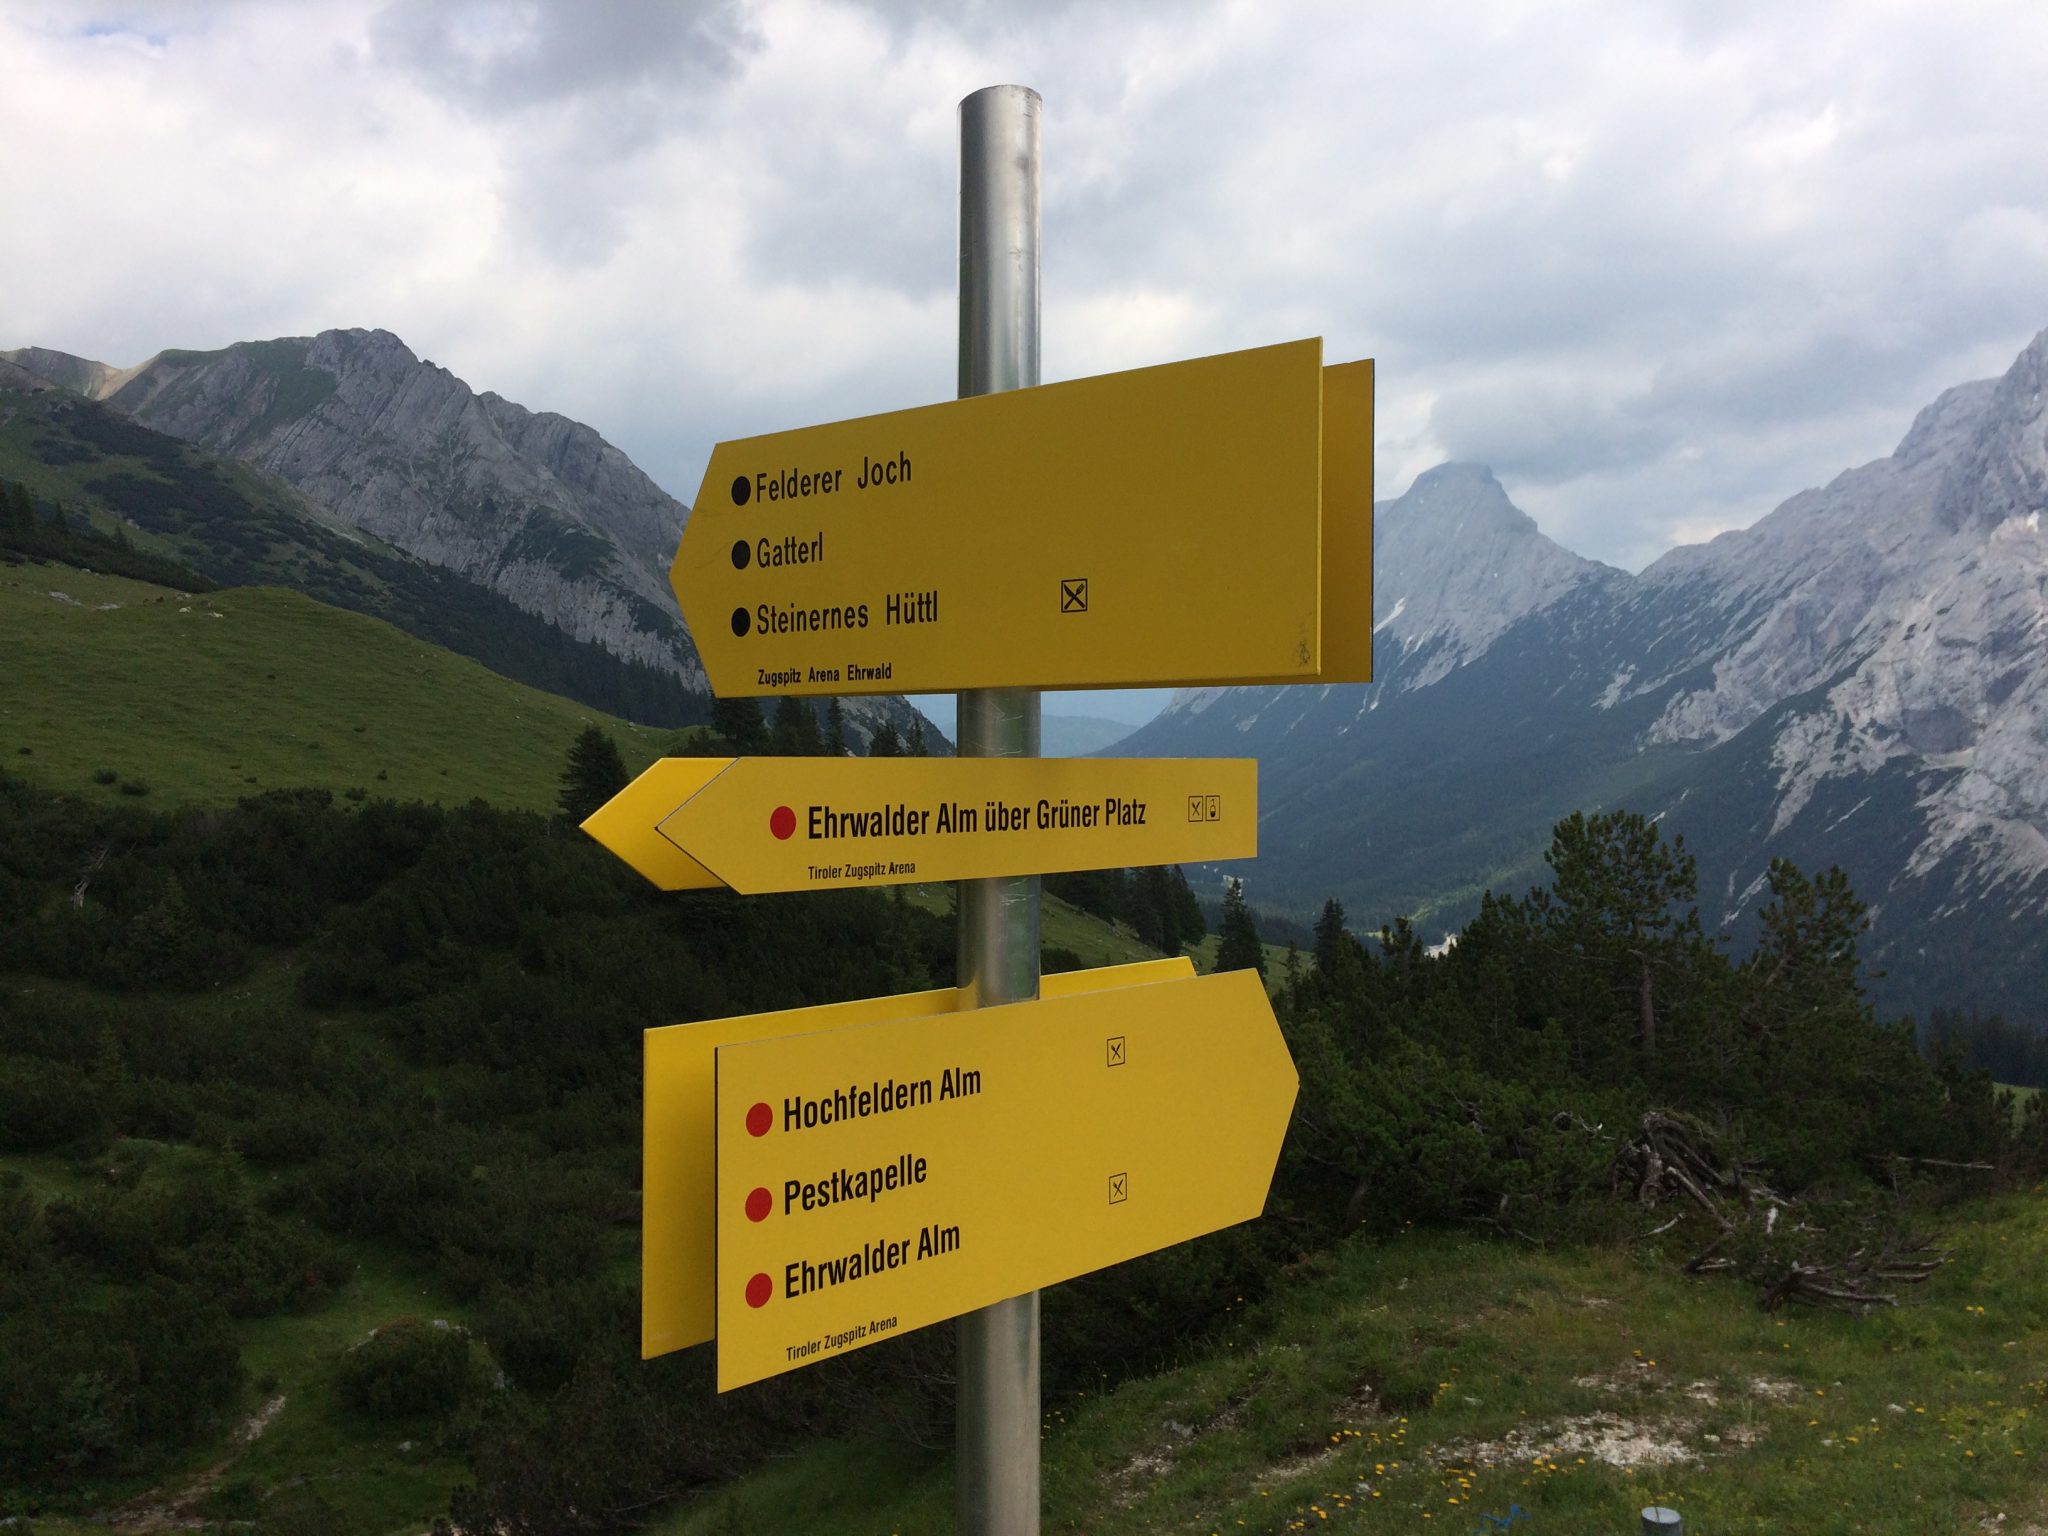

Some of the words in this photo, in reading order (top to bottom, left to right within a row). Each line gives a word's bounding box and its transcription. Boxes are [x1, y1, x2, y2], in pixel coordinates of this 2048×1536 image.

[756, 467, 843, 503] Felderer
[857, 450, 912, 490] Joch
[756, 531, 823, 569] Gatterl
[757, 602, 869, 635] Steinernes
[886, 590, 938, 626] Hüttl
[757, 667, 802, 688] Zugspitz
[808, 666, 840, 683] Arena
[847, 662, 892, 681] Ehrwald
[808, 803, 930, 840] Ehrwalder
[935, 802, 977, 834] Alm
[985, 801, 1031, 832] über
[1036, 799, 1100, 830] Grüner
[1105, 797, 1146, 826] Platz
[807, 865, 843, 880] Tiroler
[844, 862, 886, 881] Zugspitz
[888, 861, 916, 875] Arena
[784, 1079, 932, 1132] Hochfeldern
[939, 1067, 981, 1101] Alm
[784, 1153, 927, 1216] Pestkapelle
[785, 1239, 911, 1299] Ehrwalder
[917, 1224, 960, 1261] Alm
[786, 1341, 821, 1362] Tiroler
[824, 1325, 866, 1349] Zugspitz
[869, 1316, 897, 1335] Arena
